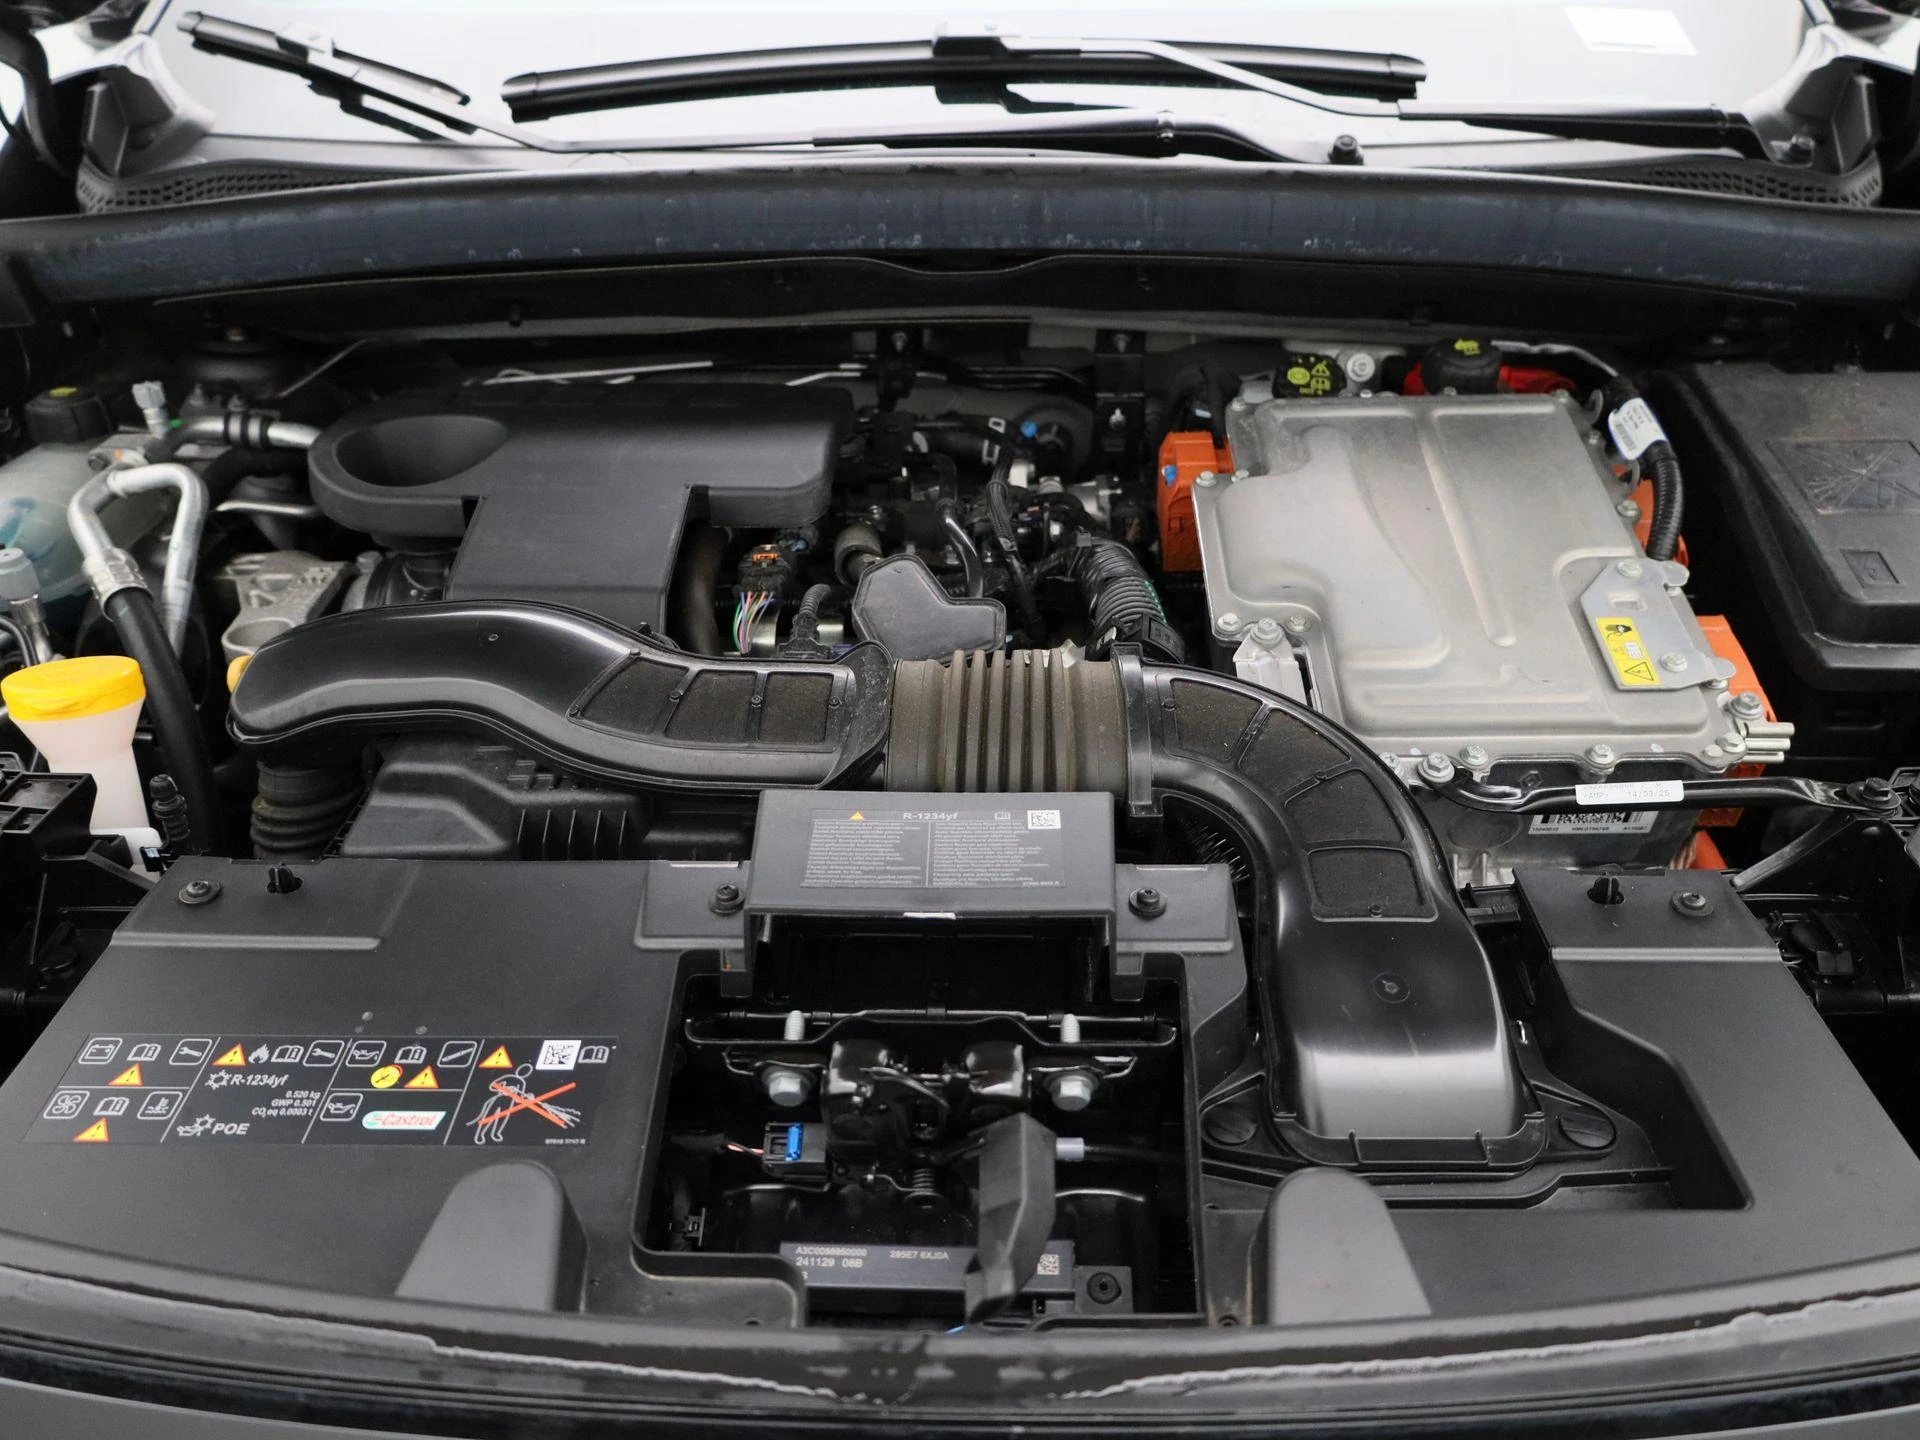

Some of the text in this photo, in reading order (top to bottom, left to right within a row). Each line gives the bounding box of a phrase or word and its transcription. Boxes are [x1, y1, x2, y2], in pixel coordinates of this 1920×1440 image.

[903, 812, 959, 821] R-1234yf
[230, 1074, 289, 1088] R-1234yf
[309, 1090, 321, 1100] kg
[271, 1099, 294, 1107] GWP
[382, 1113, 437, 1126] Castrol
[211, 1123, 250, 1135] POE
[795, 1256, 835, 1267] 241129
